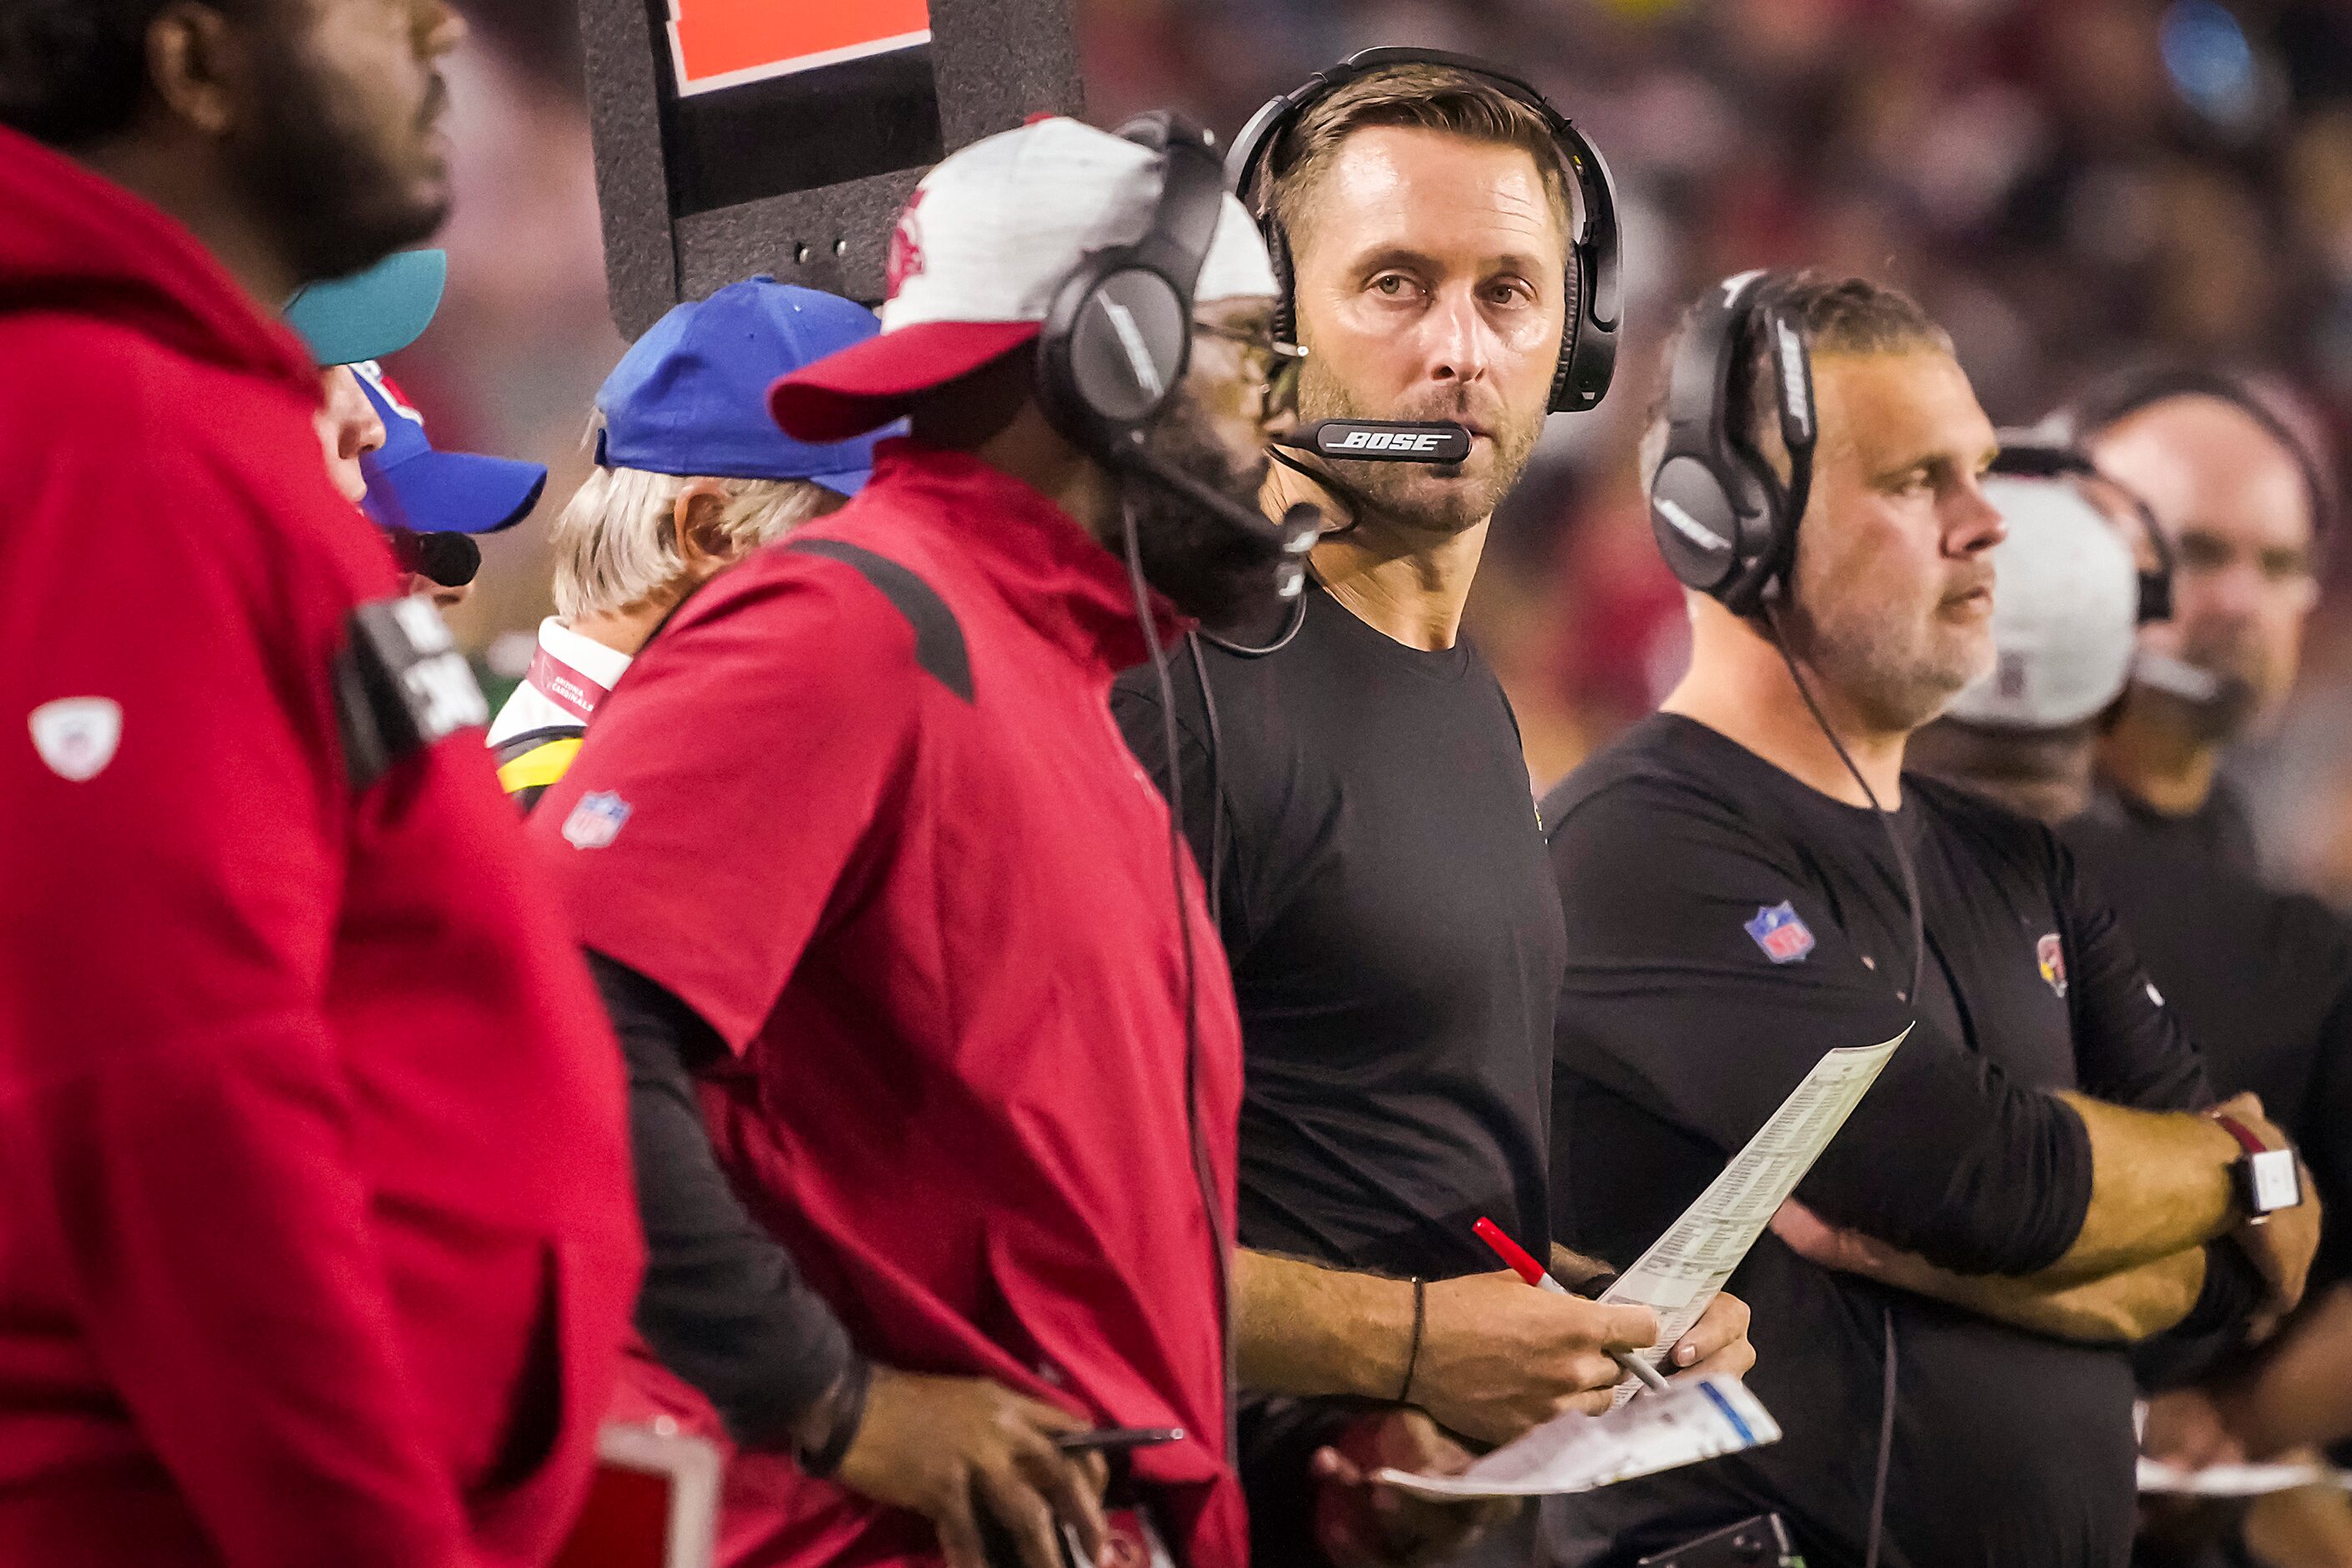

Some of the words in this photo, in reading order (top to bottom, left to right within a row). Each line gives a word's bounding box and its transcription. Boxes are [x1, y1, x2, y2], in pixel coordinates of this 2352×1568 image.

[1326, 432, 1452, 451] BOSE
[551, 682, 594, 711] CARDINALS
[555, 676, 584, 697] ARIZONA
